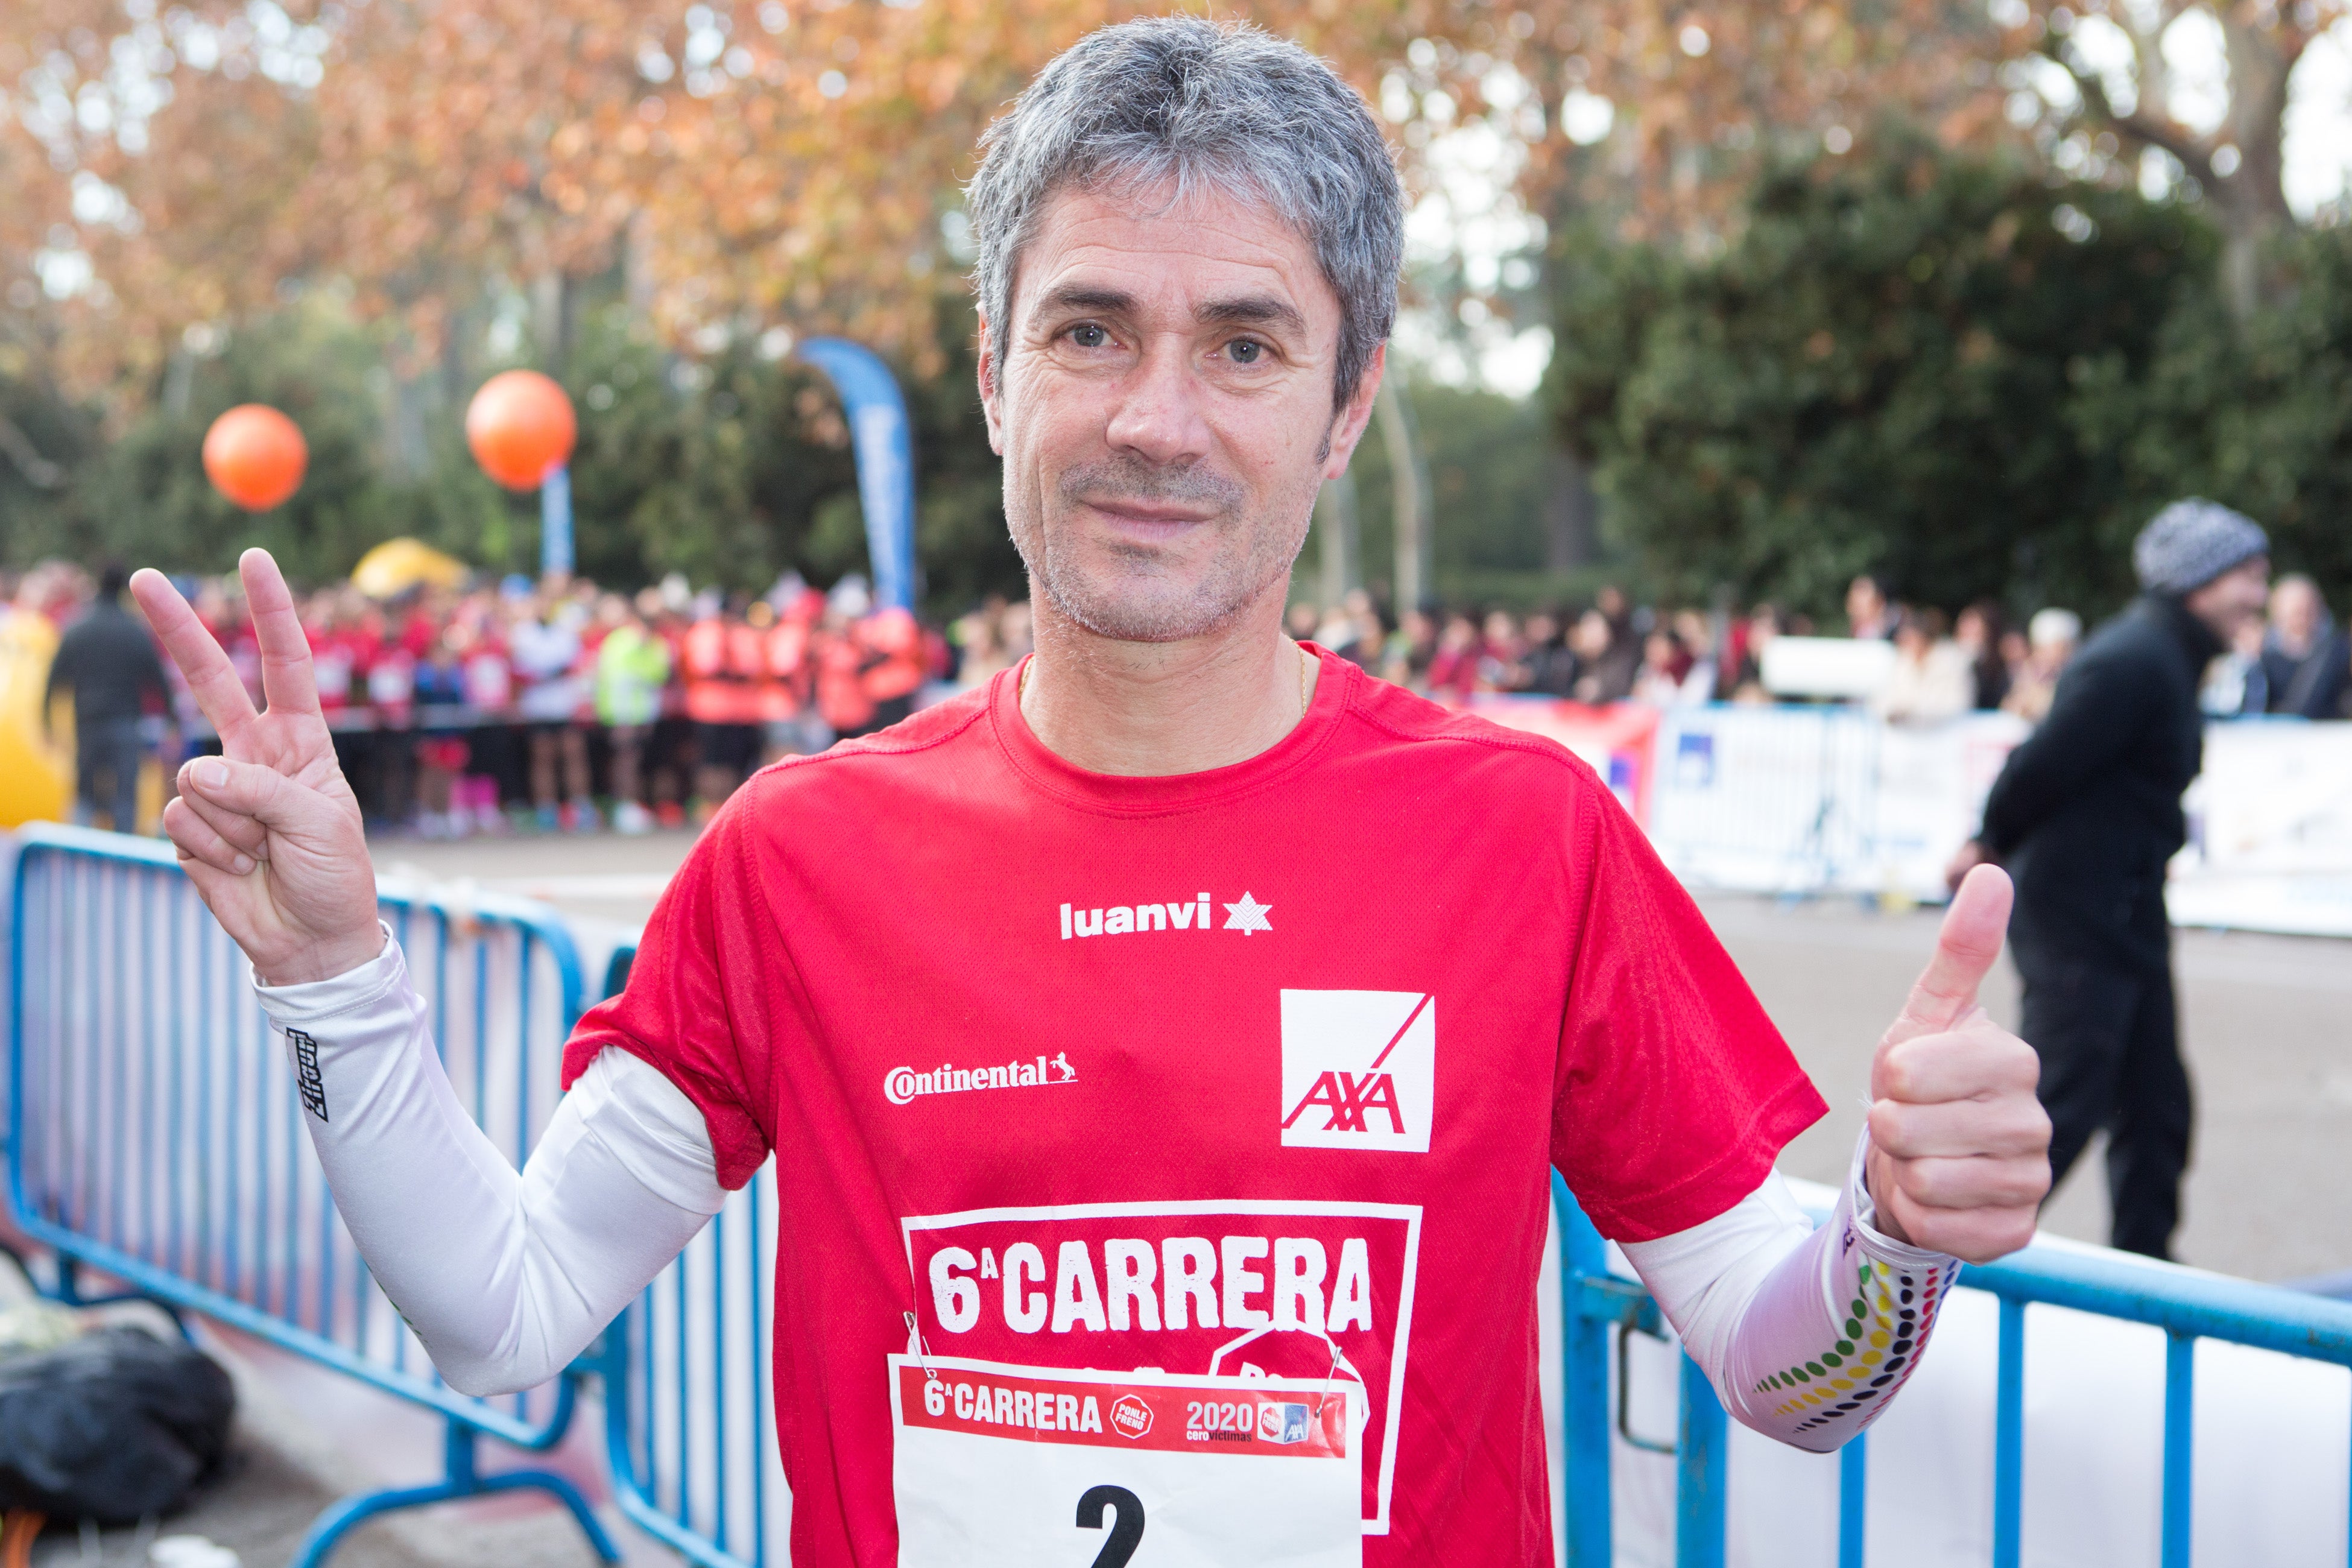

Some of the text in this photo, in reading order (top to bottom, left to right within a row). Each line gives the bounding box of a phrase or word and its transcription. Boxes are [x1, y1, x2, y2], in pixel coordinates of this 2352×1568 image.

[1060, 892, 1211, 940] luanvi
[884, 1056, 1049, 1105] Continental
[1282, 1070, 1406, 1134] AXA
[1002, 1236, 1373, 1335] CARRERA
[954, 1383, 1102, 1434] CARRERA
[1115, 1412, 1144, 1430] FRENO
[1118, 1403, 1147, 1422] PONLE
[1186, 1401, 1253, 1432] 2020
[1285, 1423, 1305, 1440] AXA
[1076, 1485, 1145, 1568] 2
